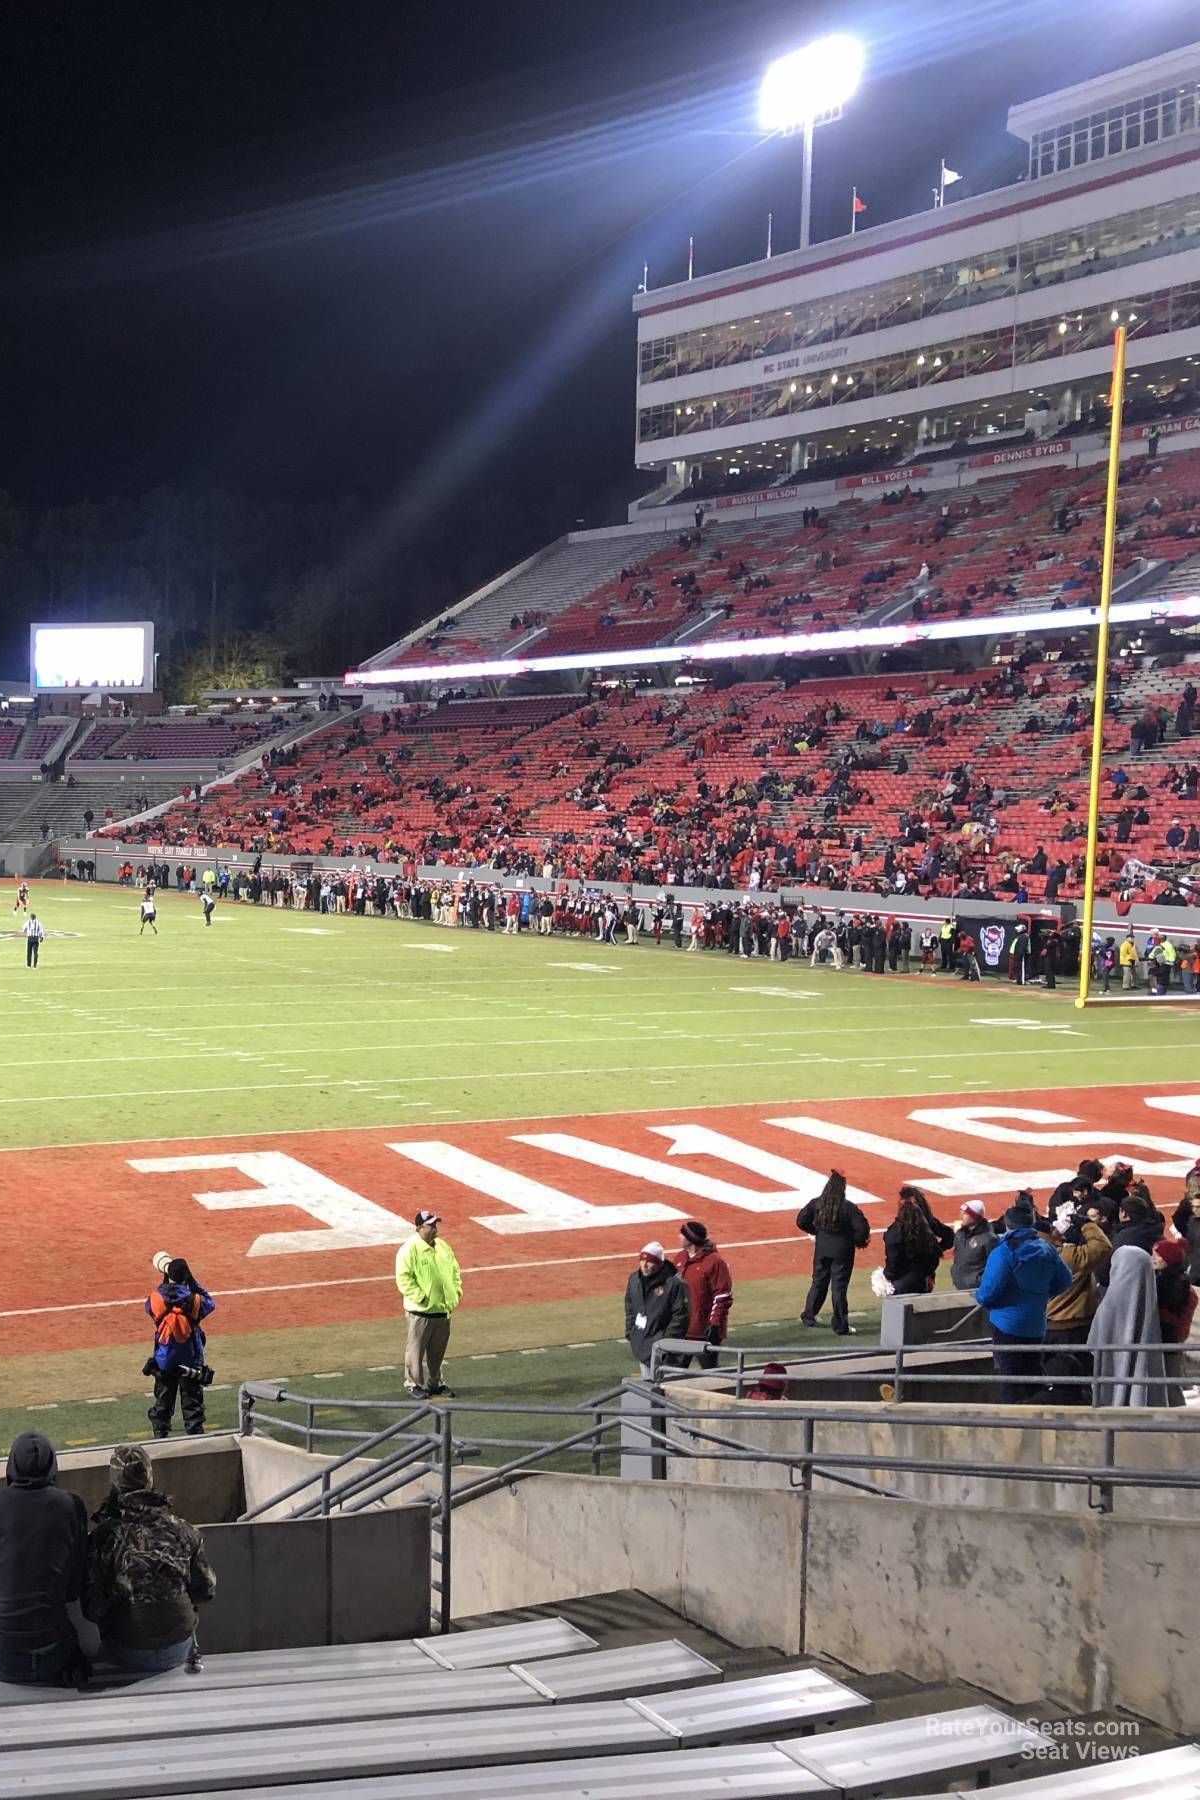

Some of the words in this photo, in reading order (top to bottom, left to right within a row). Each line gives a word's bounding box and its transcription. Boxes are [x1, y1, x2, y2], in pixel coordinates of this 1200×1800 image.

[763, 364, 775, 375] NC
[777, 357, 800, 371] STATE
[802, 347, 848, 366] UNIVERSITY
[993, 450, 1032, 464] DENNIS
[1035, 443, 1063, 456] BYRD
[861, 474, 881, 485] BILL
[884, 469, 914, 482] YOEST
[732, 493, 766, 506] RUSSELL
[767, 488, 796, 500] WILSON
[164, 847, 175, 856] DAY
[175, 847, 193, 857] FAMILY
[193, 848, 208, 857] FIELD
